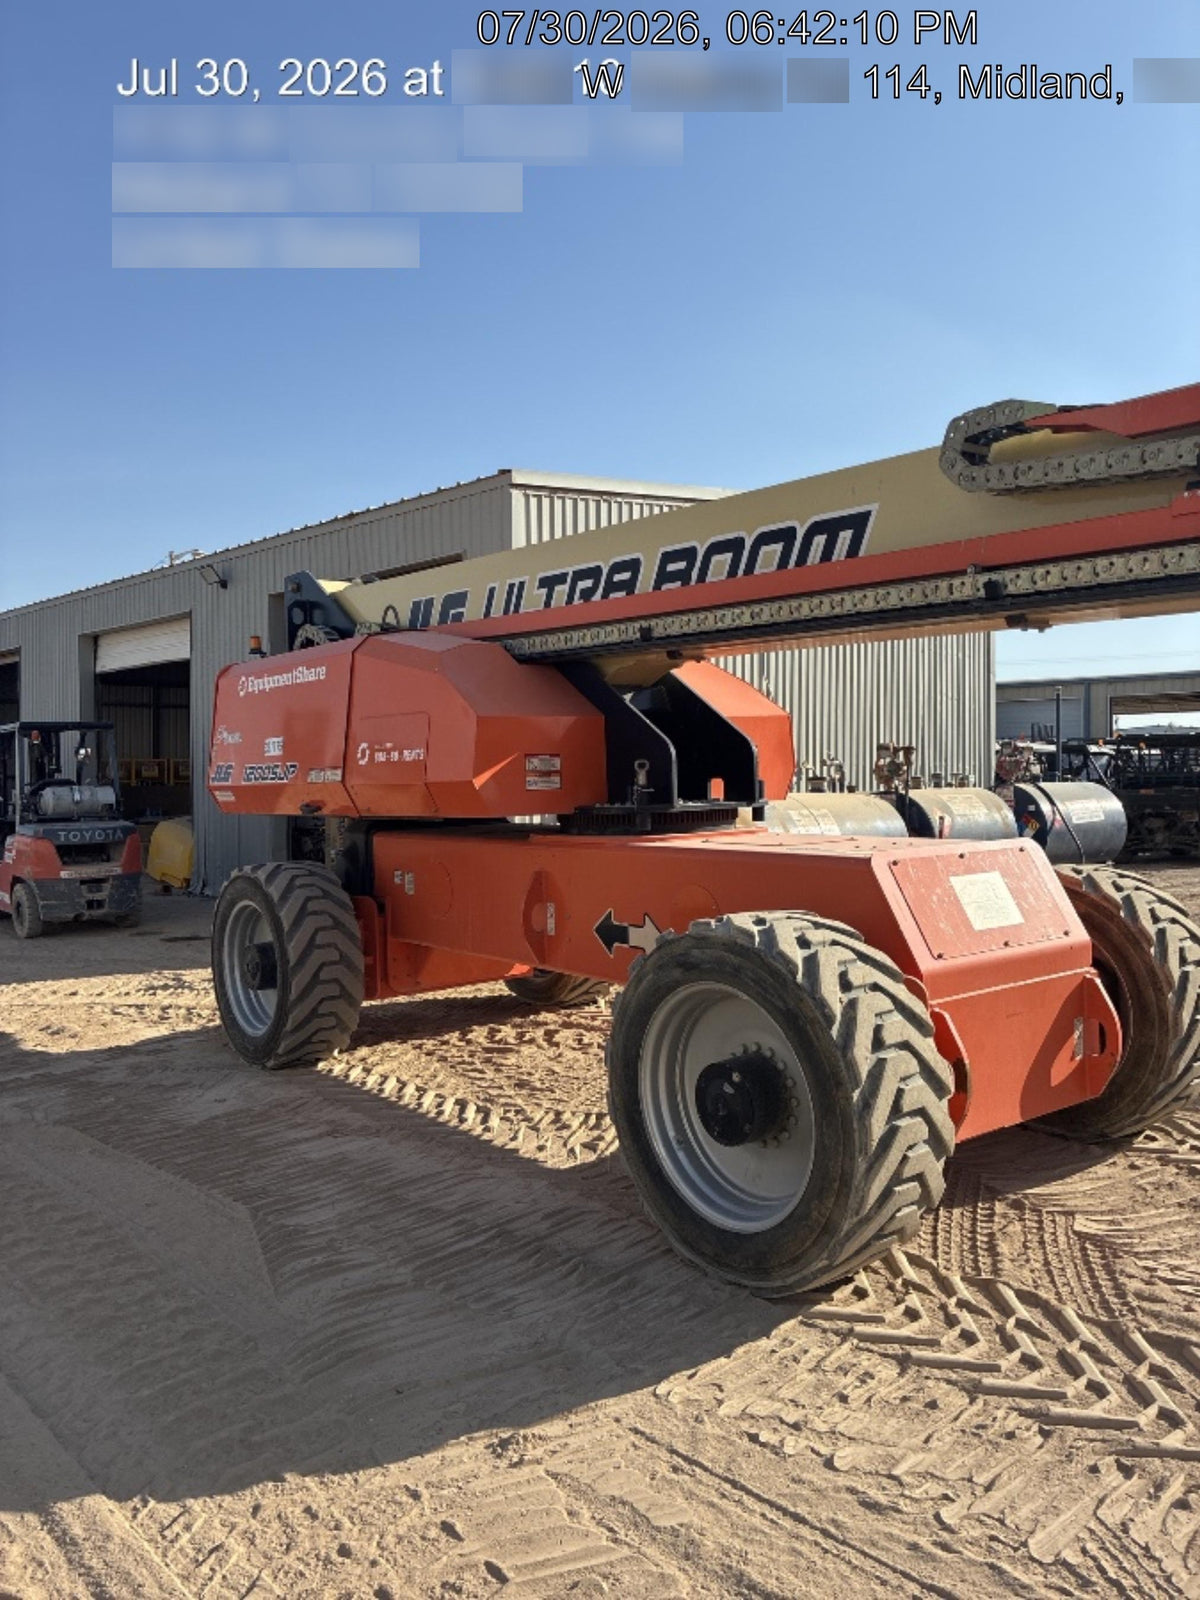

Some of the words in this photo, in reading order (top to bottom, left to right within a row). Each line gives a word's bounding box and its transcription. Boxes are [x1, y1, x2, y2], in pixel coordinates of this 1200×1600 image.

[483, 551, 645, 620] ULTRA
[650, 503, 880, 592] BOOM
[247, 665, 327, 694] EquipmentShare
[58, 829, 124, 842] TOYOTA
